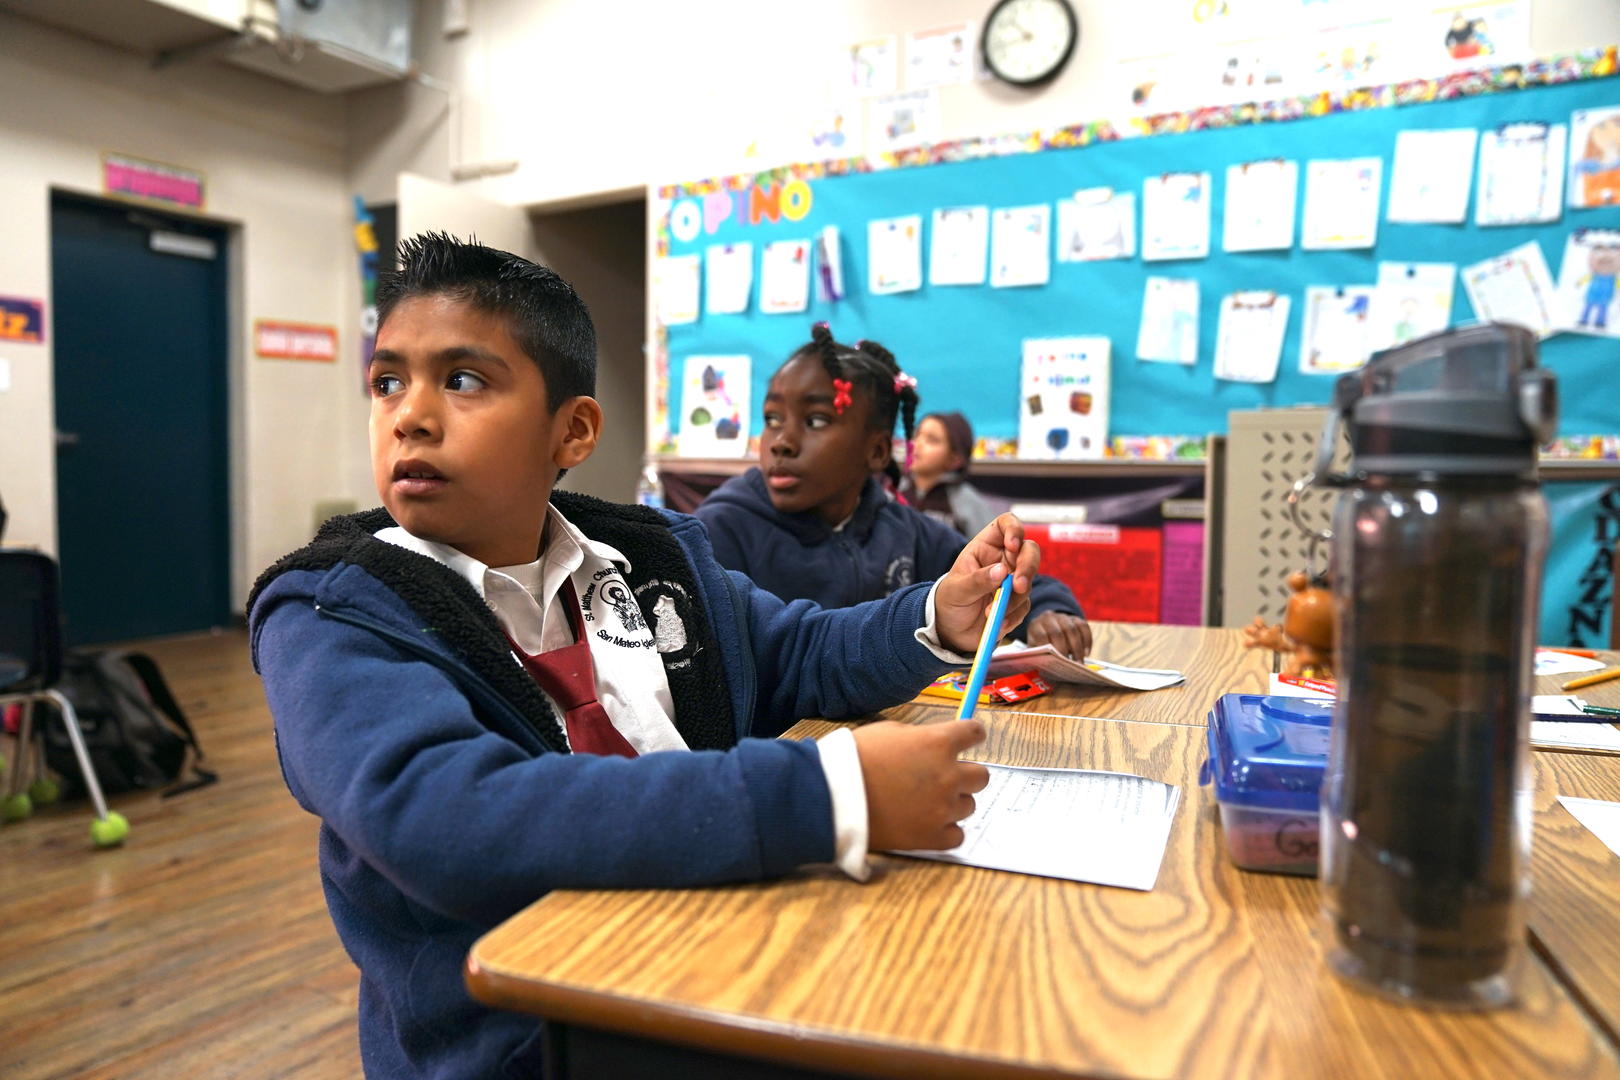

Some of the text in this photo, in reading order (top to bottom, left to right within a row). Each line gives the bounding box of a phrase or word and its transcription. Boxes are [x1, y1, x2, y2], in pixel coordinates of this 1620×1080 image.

[670, 179, 812, 241] OPINO
[584, 612, 595, 622] St.
[597, 629, 613, 643] San
[613, 636, 640, 648] Mateo
